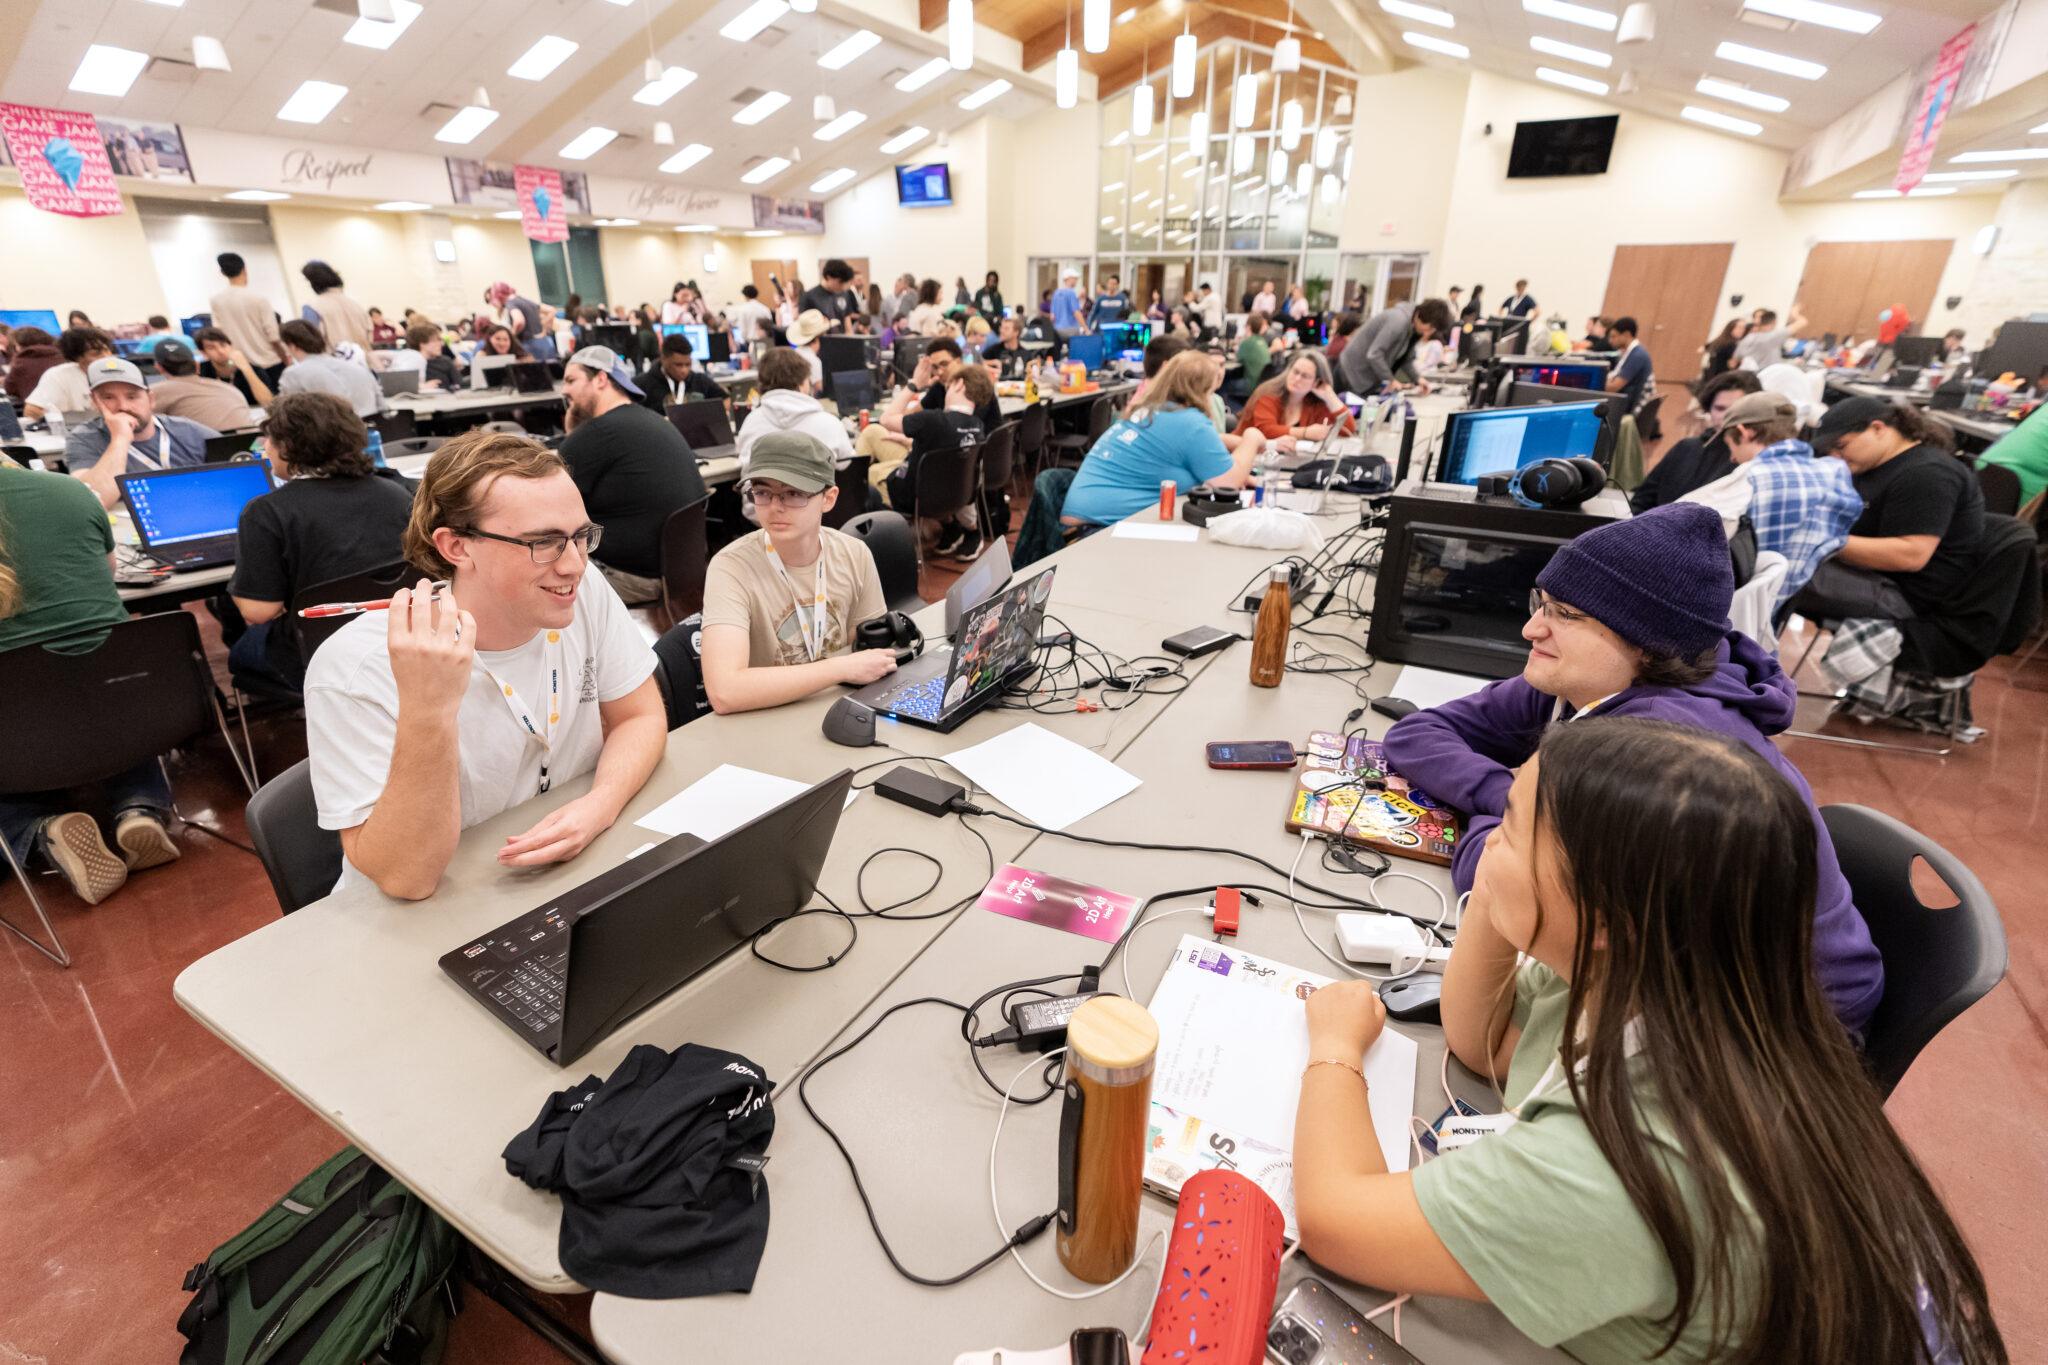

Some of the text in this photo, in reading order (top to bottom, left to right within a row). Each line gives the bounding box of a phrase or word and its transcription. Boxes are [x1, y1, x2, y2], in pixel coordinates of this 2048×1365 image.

[2, 115, 99, 139] GAME JAM
[281, 148, 374, 190] Respect
[31, 197, 125, 215] GAME JAM
[1381, 794, 1420, 815] rice
[1013, 877, 1036, 904] 2D Art
[1086, 896, 1108, 924] 2D Art
[1188, 949, 1200, 964] LSU
